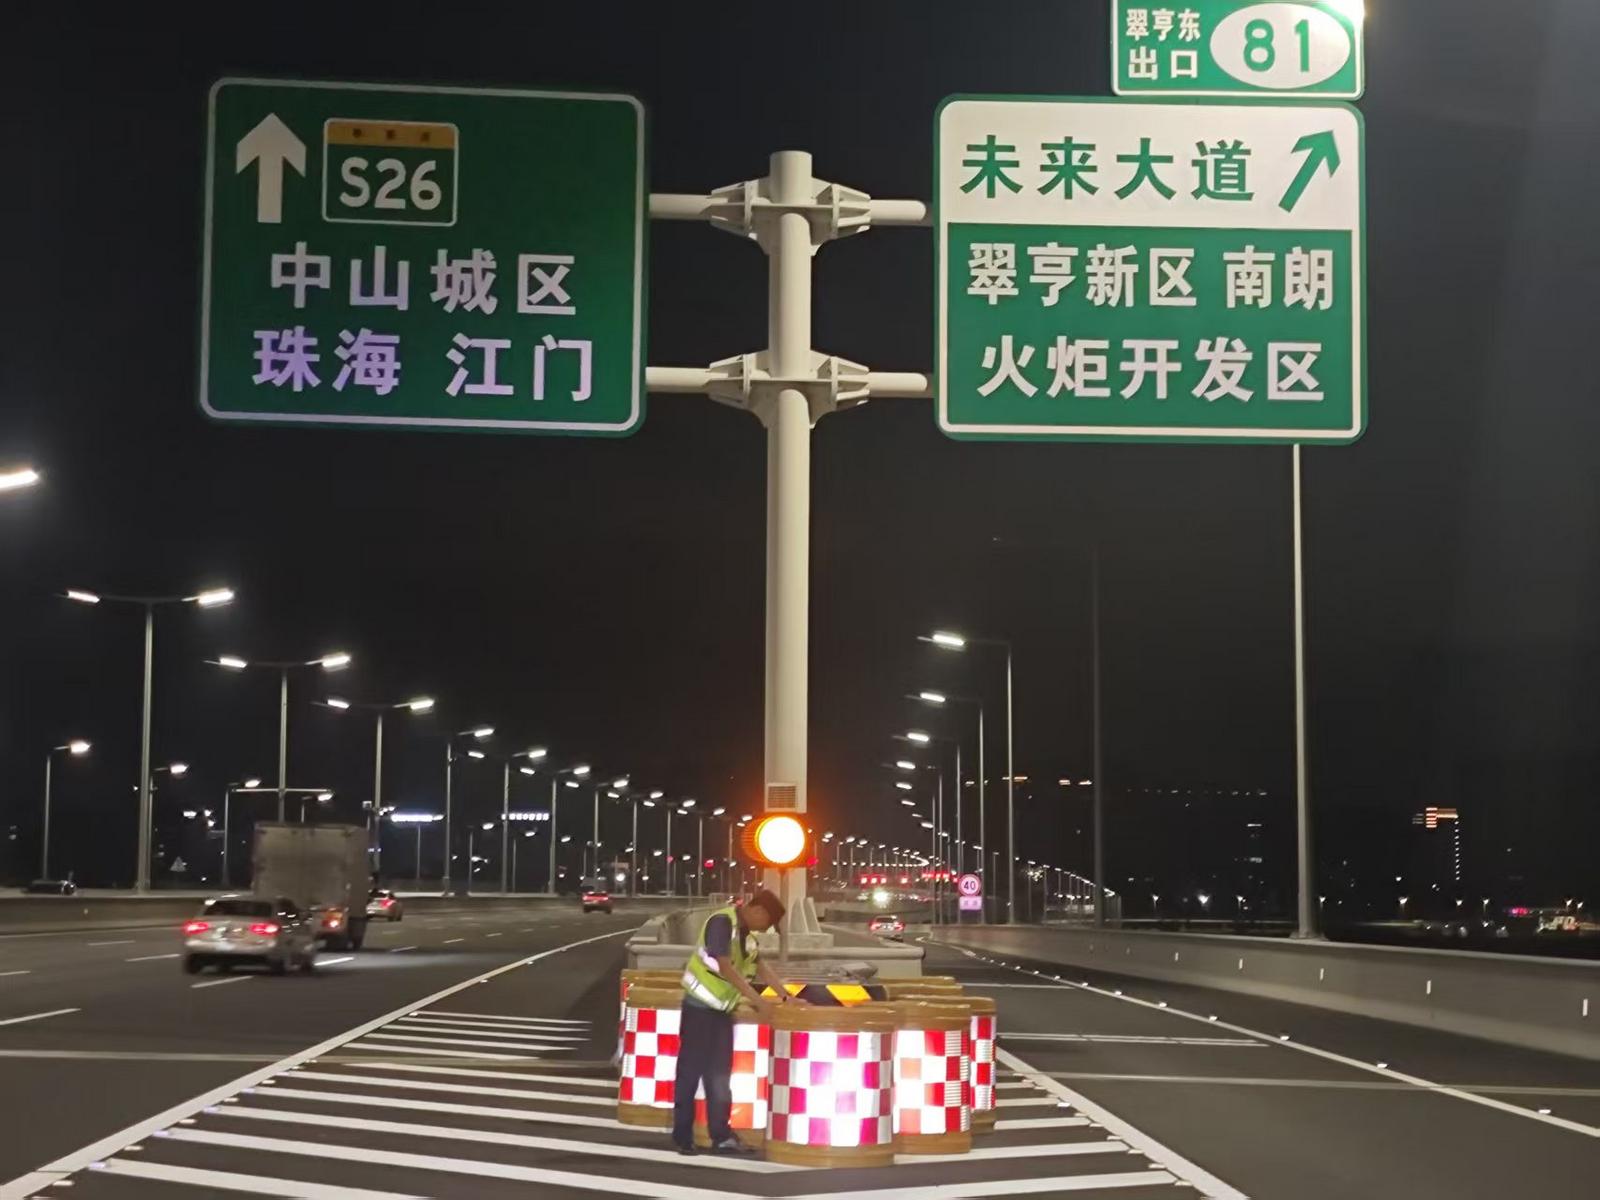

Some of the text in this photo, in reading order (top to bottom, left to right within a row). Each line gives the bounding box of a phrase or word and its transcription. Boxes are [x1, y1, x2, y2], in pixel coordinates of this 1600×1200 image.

[1126, 8, 1200, 41] 翠亨东
[1243, 18, 1310, 72] 81
[1128, 46, 1198, 80] 出口
[339, 156, 442, 211] S26
[959, 134, 1255, 201] 未来大道
[270, 241, 576, 315] 中山城区
[967, 242, 1334, 310] 翠亨新区 南朗
[252, 326, 593, 402] 珠海 江门
[977, 335, 1325, 402] 火炬开发区
[963, 880, 976, 890] 40
